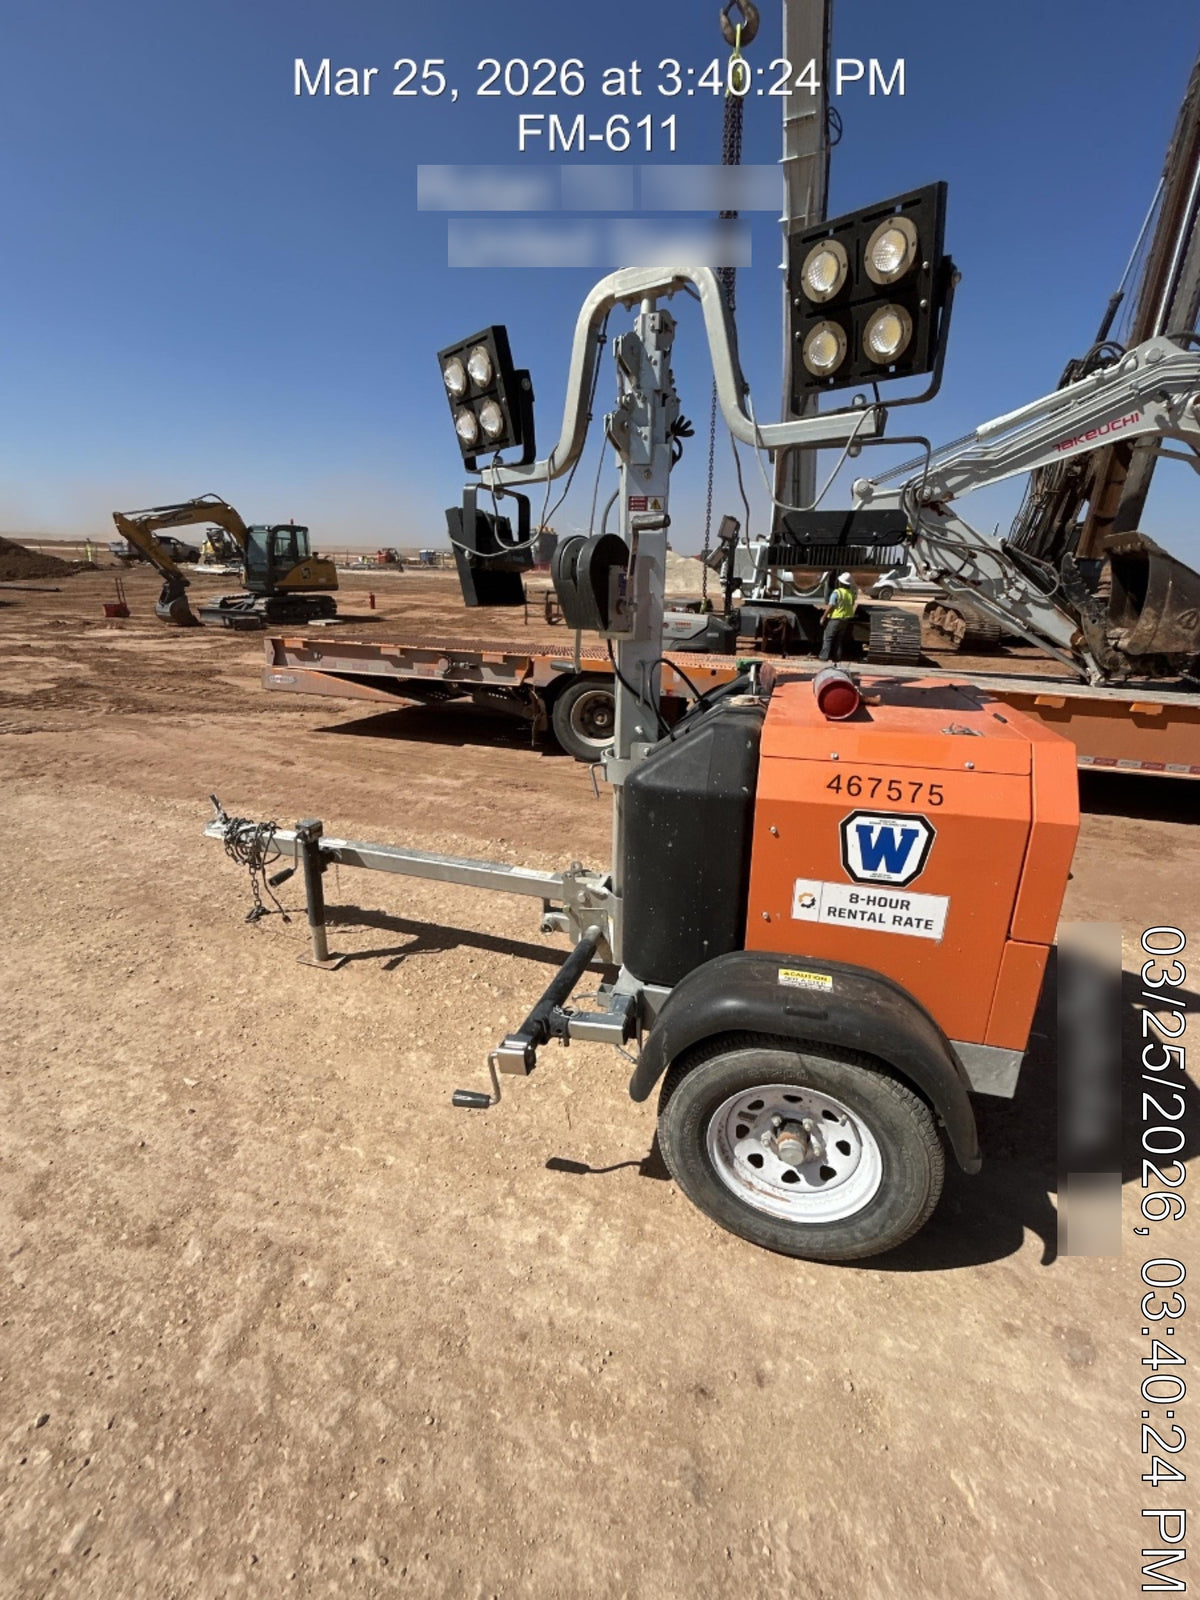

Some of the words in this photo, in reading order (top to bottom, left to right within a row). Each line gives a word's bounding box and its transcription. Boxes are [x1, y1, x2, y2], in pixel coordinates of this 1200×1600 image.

[826, 774, 944, 806] 467575
[855, 824, 919, 875] W
[849, 893, 911, 911] 8-HOUR
[827, 906, 886, 924] RENTAL
[892, 915, 934, 930] RATE
[790, 971, 828, 981] CAUTION
